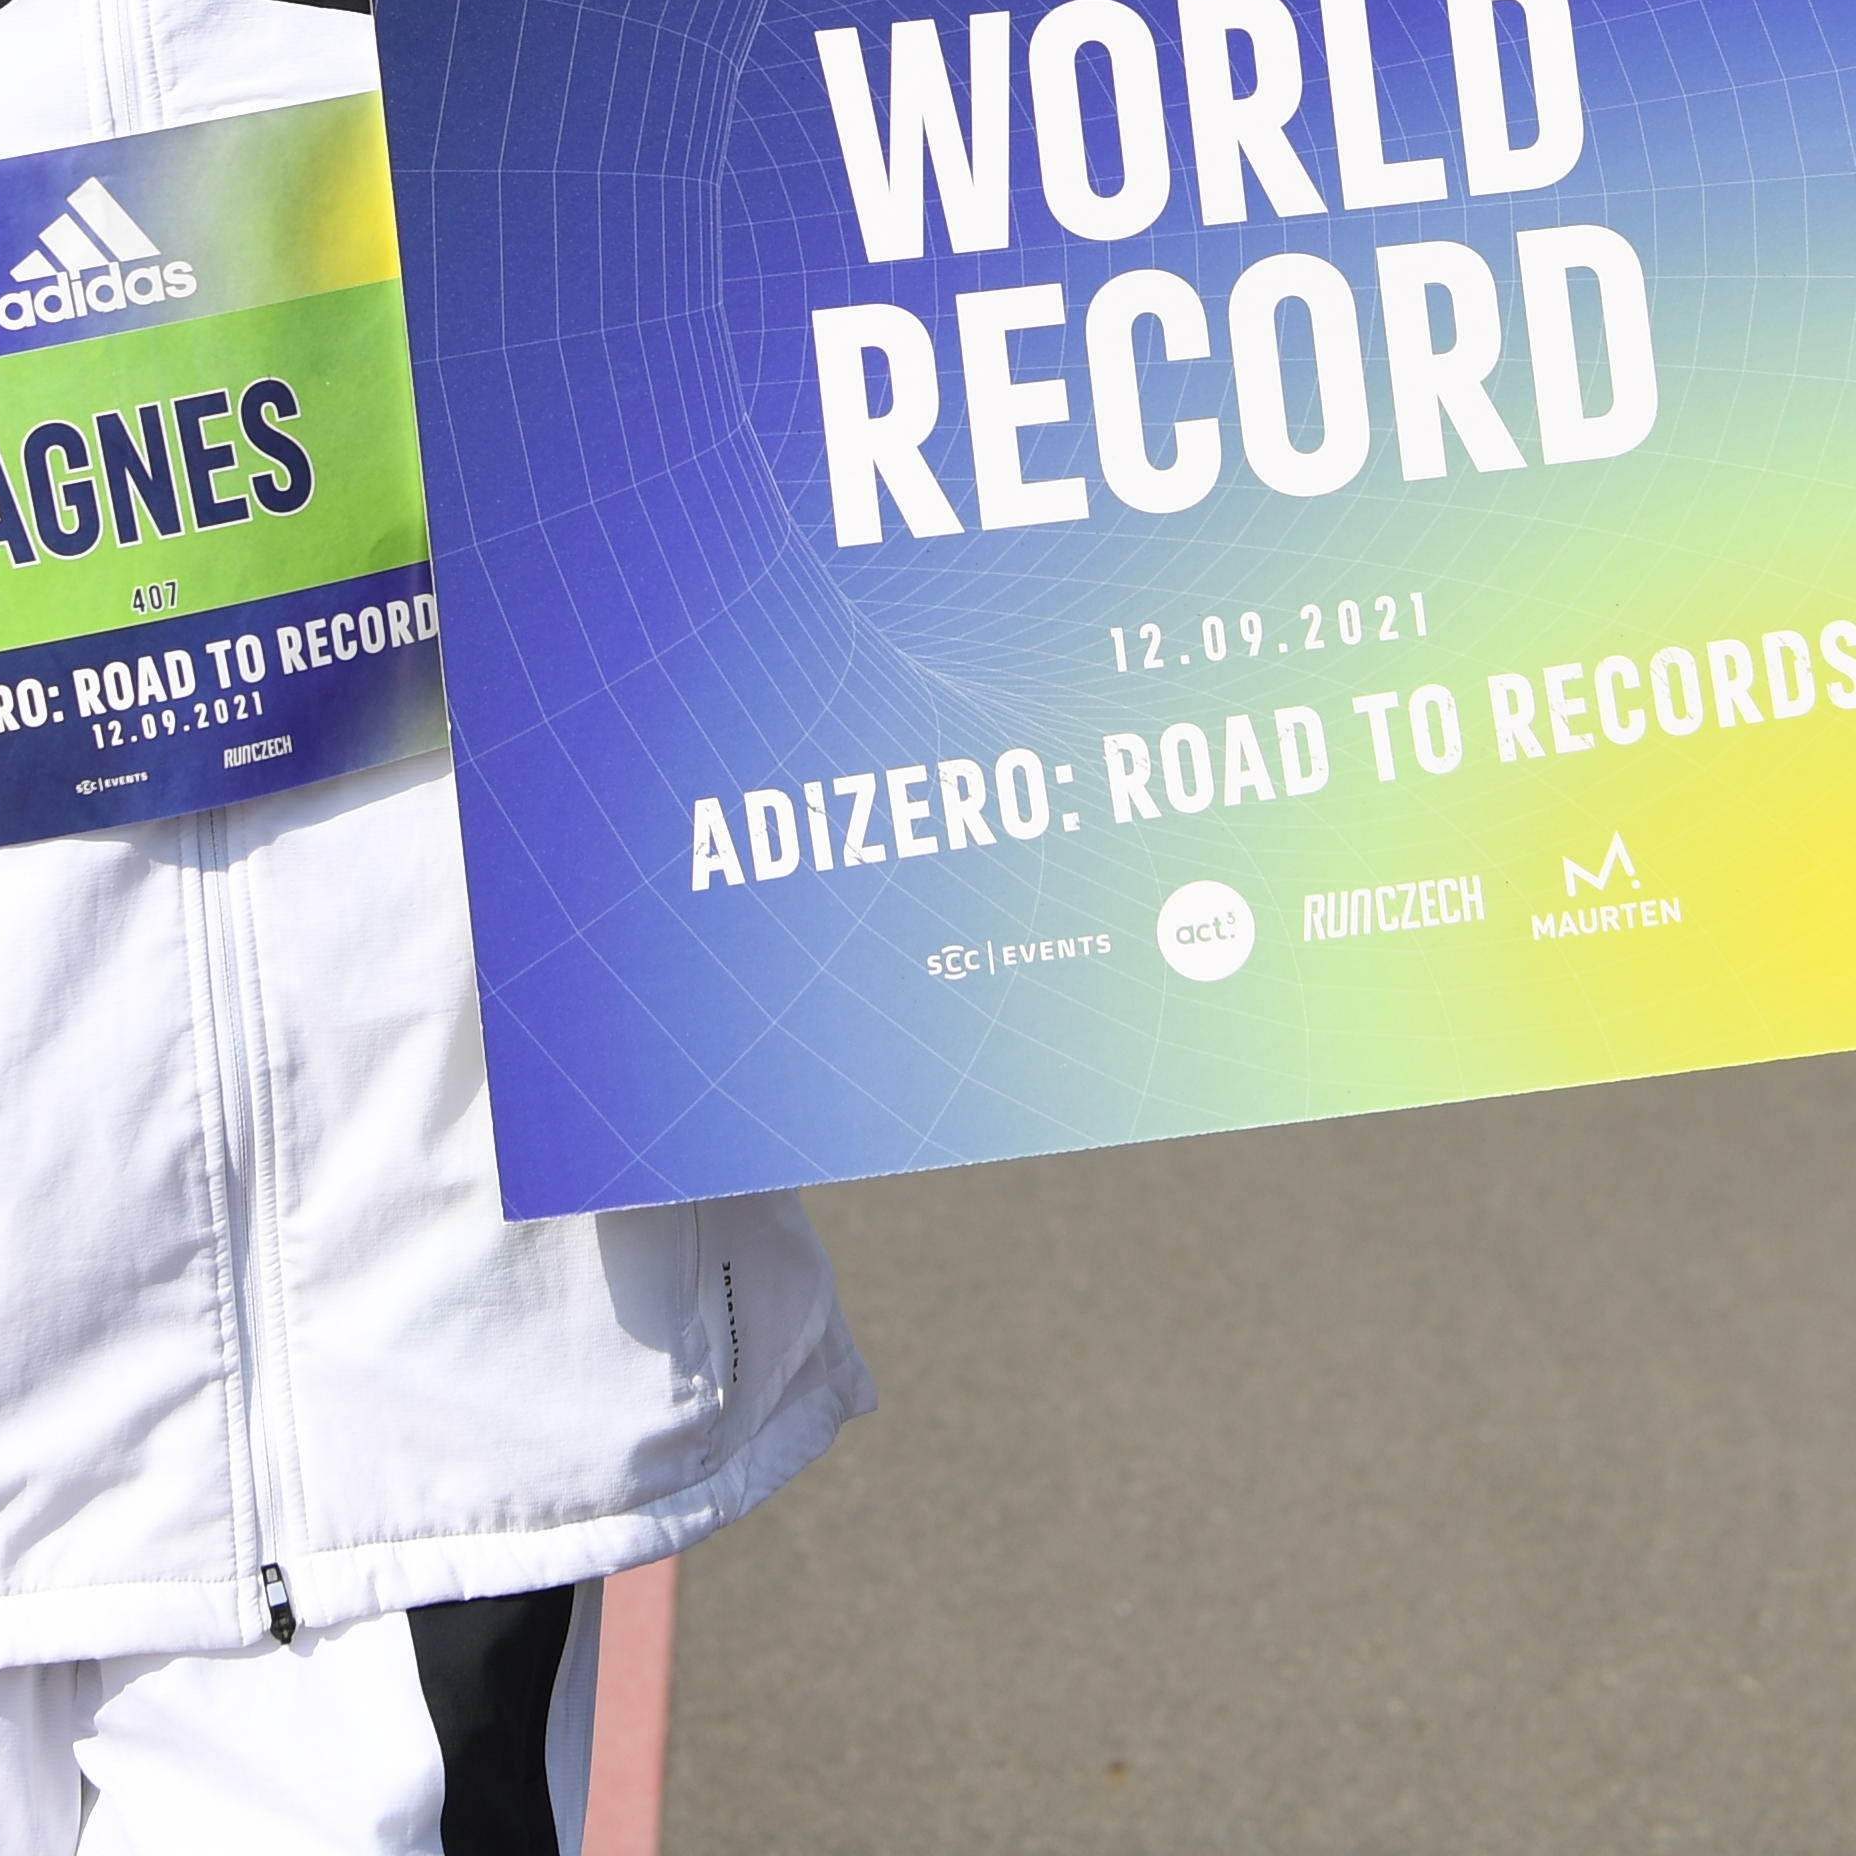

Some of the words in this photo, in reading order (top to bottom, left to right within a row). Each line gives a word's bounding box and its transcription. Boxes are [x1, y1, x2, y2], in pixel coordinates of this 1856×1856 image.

[811, 224, 1659, 548] RECORD
[131, 579, 180, 614] 407
[1110, 591, 1428, 673] 12.09.2021
[72, 648, 198, 719] ROAD
[206, 633, 267, 690] TO
[92, 691, 264, 750] 12.09.2021
[691, 746, 1081, 892] ADIZERO:
[1102, 705, 1330, 824] ROAD
[1351, 683, 1464, 783] TO
[1531, 897, 1683, 941] MAURTEN
[721, 1260, 740, 1383] PRIMEBLUE
